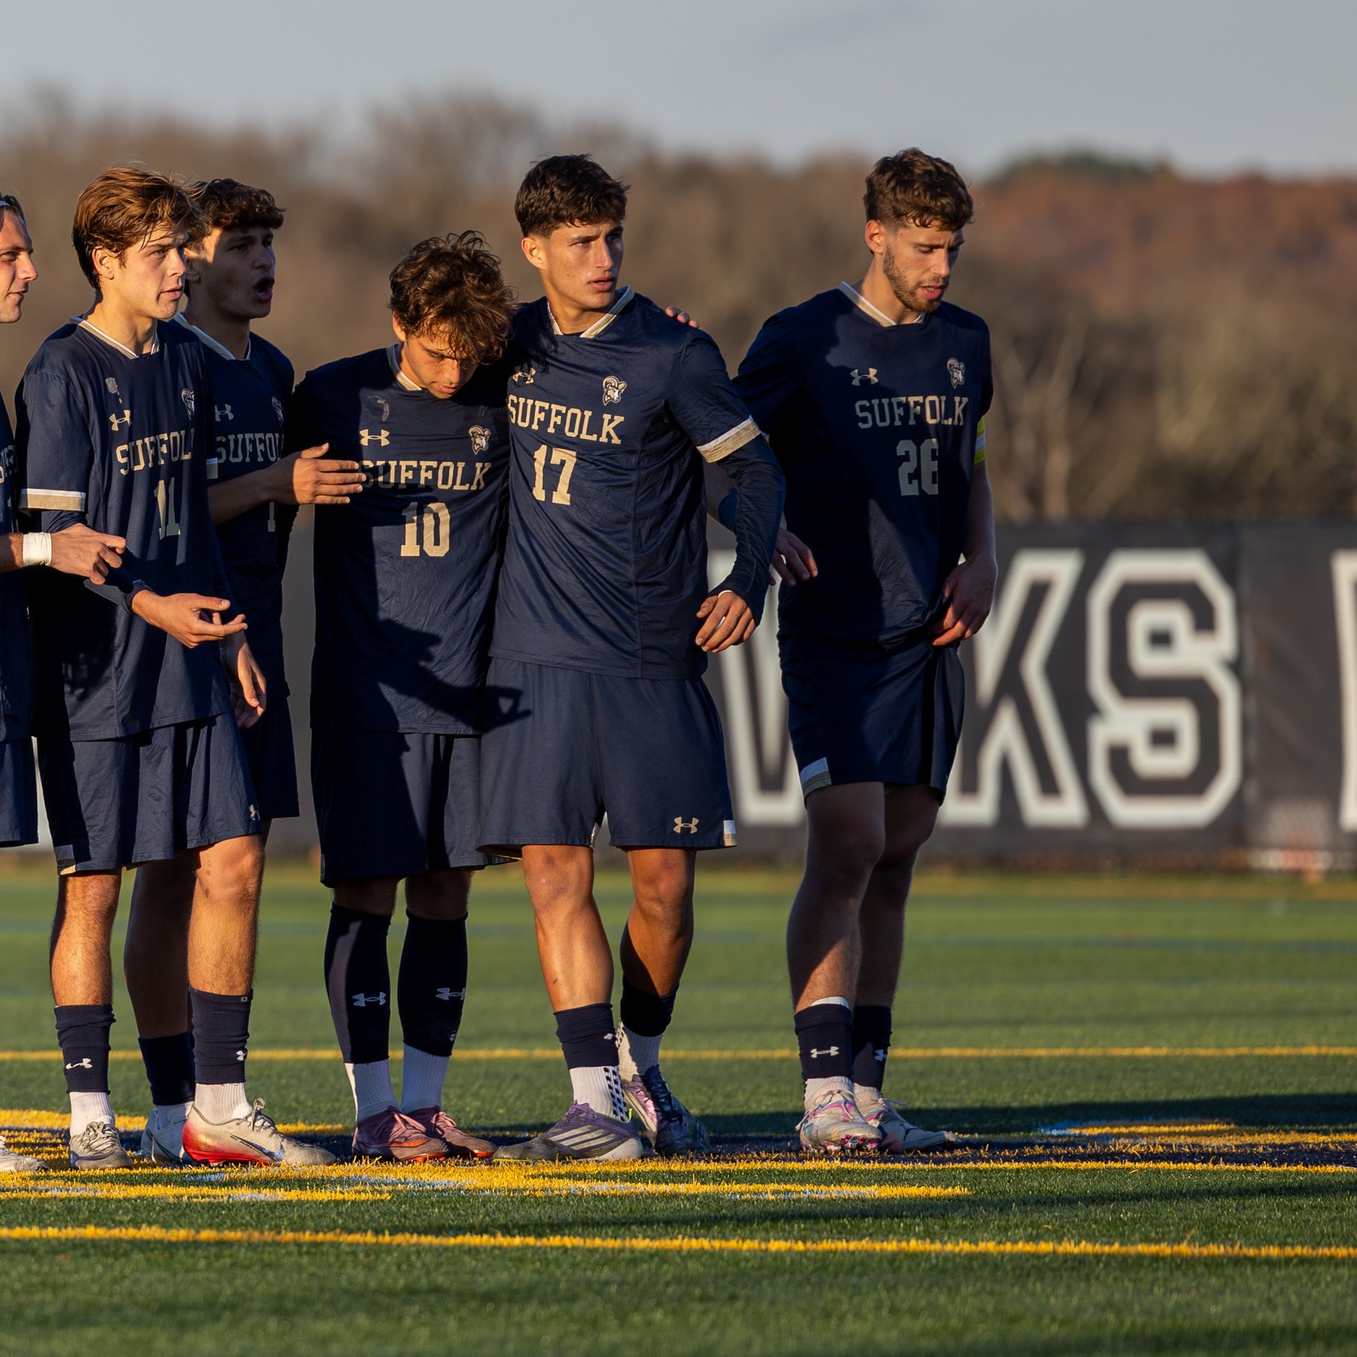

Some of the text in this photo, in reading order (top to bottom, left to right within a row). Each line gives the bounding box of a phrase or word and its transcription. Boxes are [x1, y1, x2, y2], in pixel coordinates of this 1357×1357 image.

[507, 394, 626, 445] SUFFOLK
[854, 395, 969, 429] SUFFOLK
[359, 460, 492, 491] SUFFOLK
[532, 444, 578, 506] 17
[153, 476, 181, 541] 11
[400, 501, 451, 558] 10
